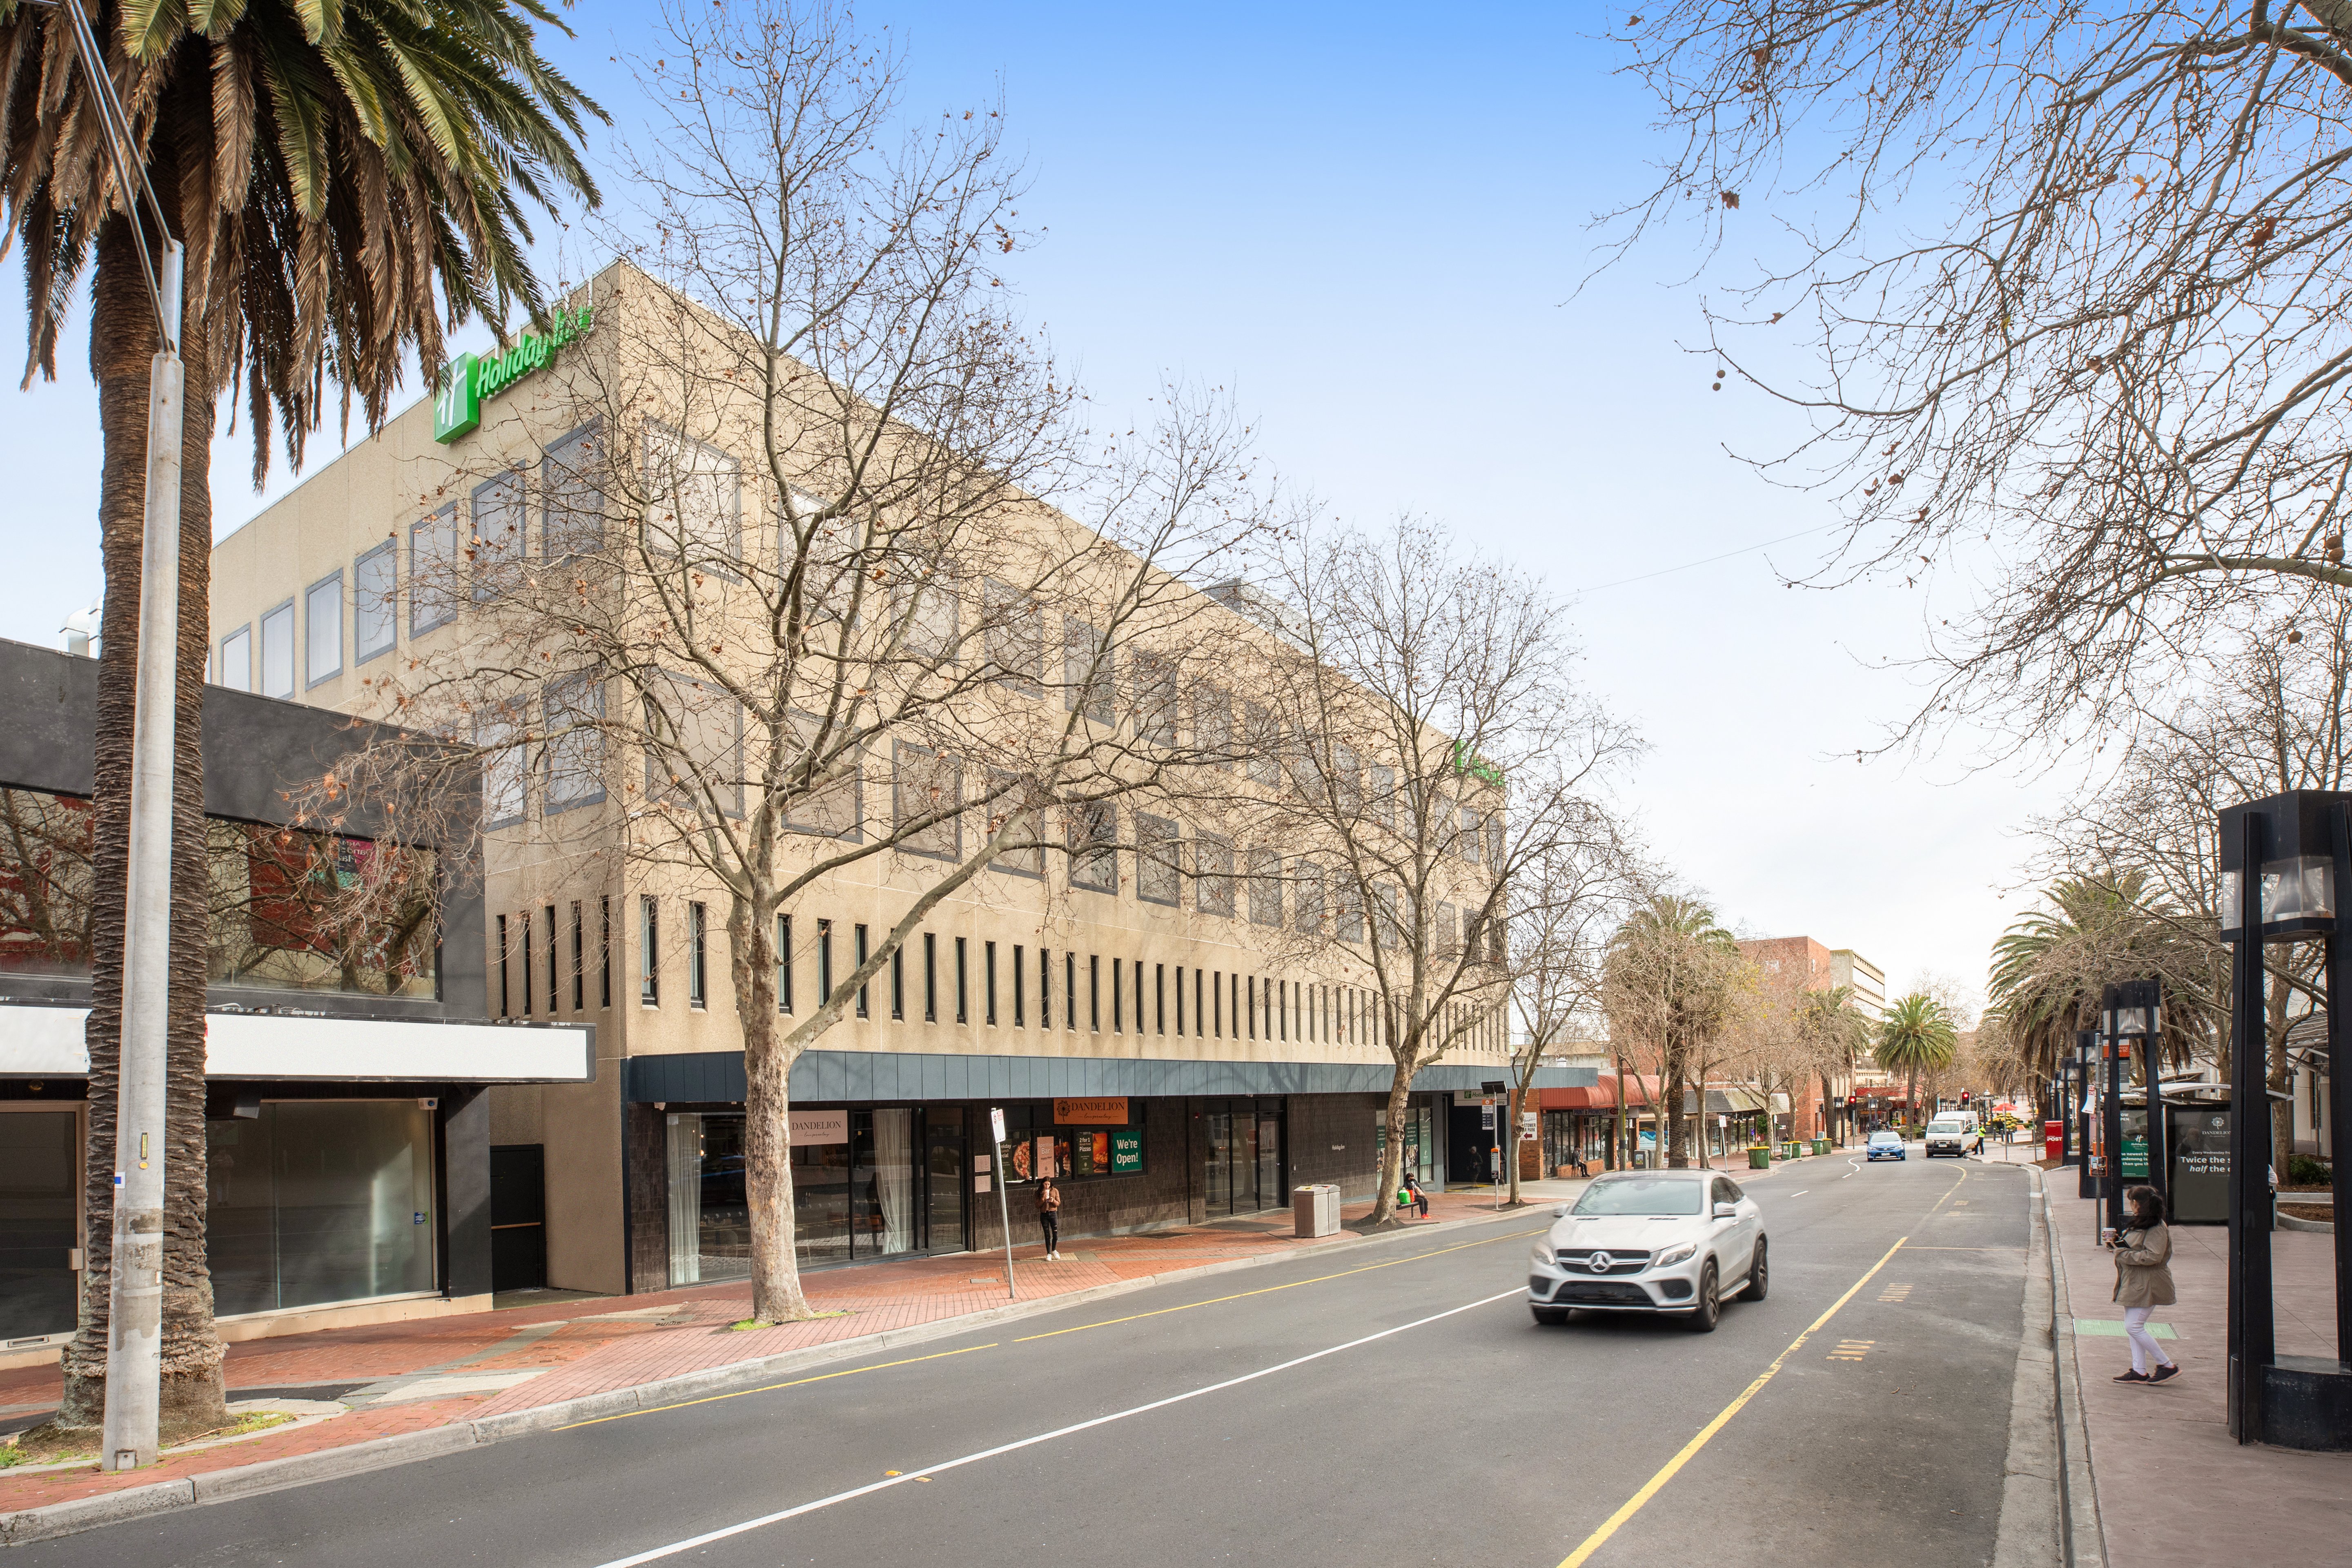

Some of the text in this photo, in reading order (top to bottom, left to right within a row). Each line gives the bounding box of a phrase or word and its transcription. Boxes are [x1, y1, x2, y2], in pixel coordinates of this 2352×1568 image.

[476, 333, 554, 399] Holiday
[1072, 1102, 1125, 1111] DANDELION
[792, 1121, 841, 1130] DANDELION
[1116, 1139, 1138, 1149] We're
[1116, 1152, 1138, 1166] Open!
